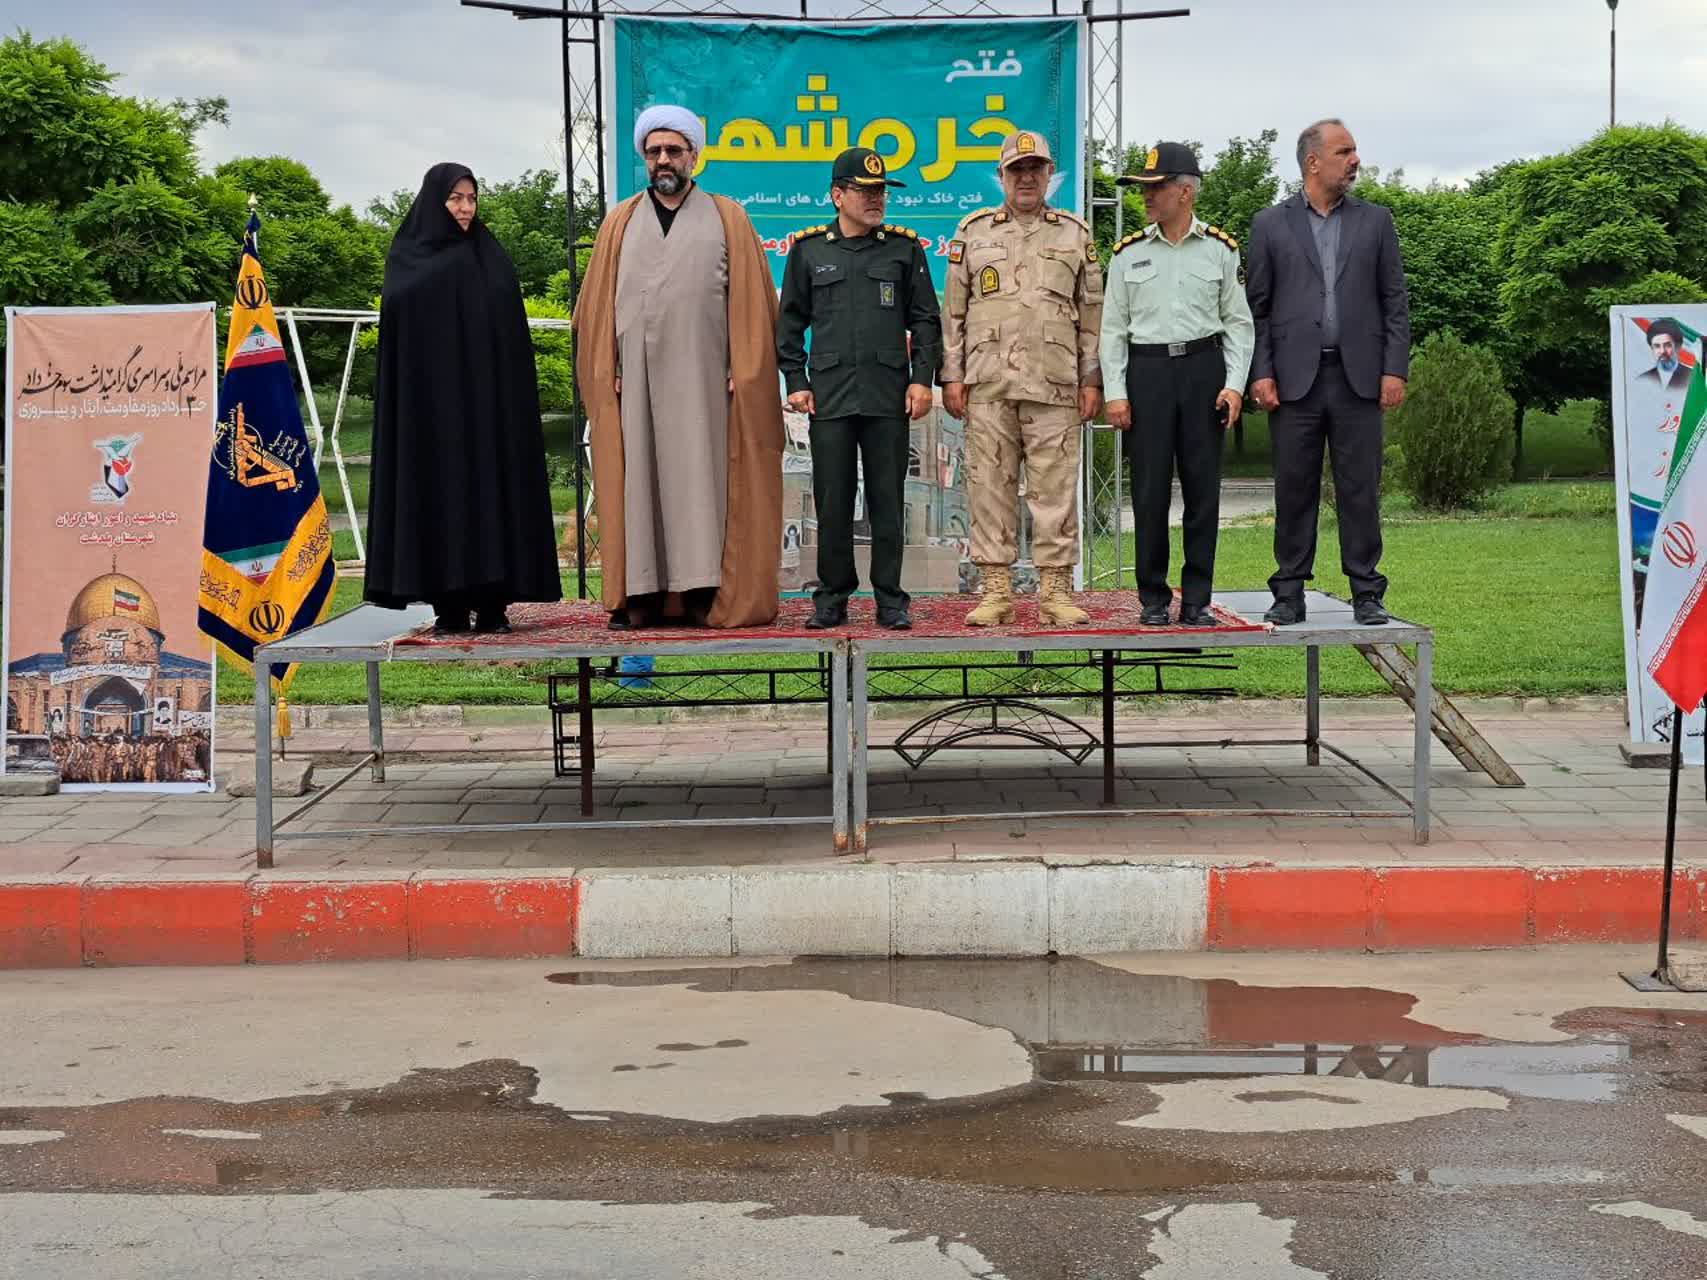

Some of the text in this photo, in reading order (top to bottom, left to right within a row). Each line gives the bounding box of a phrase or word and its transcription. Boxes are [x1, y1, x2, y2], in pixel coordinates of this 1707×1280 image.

[945, 49, 1024, 84] فتح
[736, 191, 782, 207] اسلامی
[785, 191, 812, 207] های
[895, 194, 924, 208] نبود
[927, 191, 955, 204] خاک
[957, 191, 983, 210] فتح
